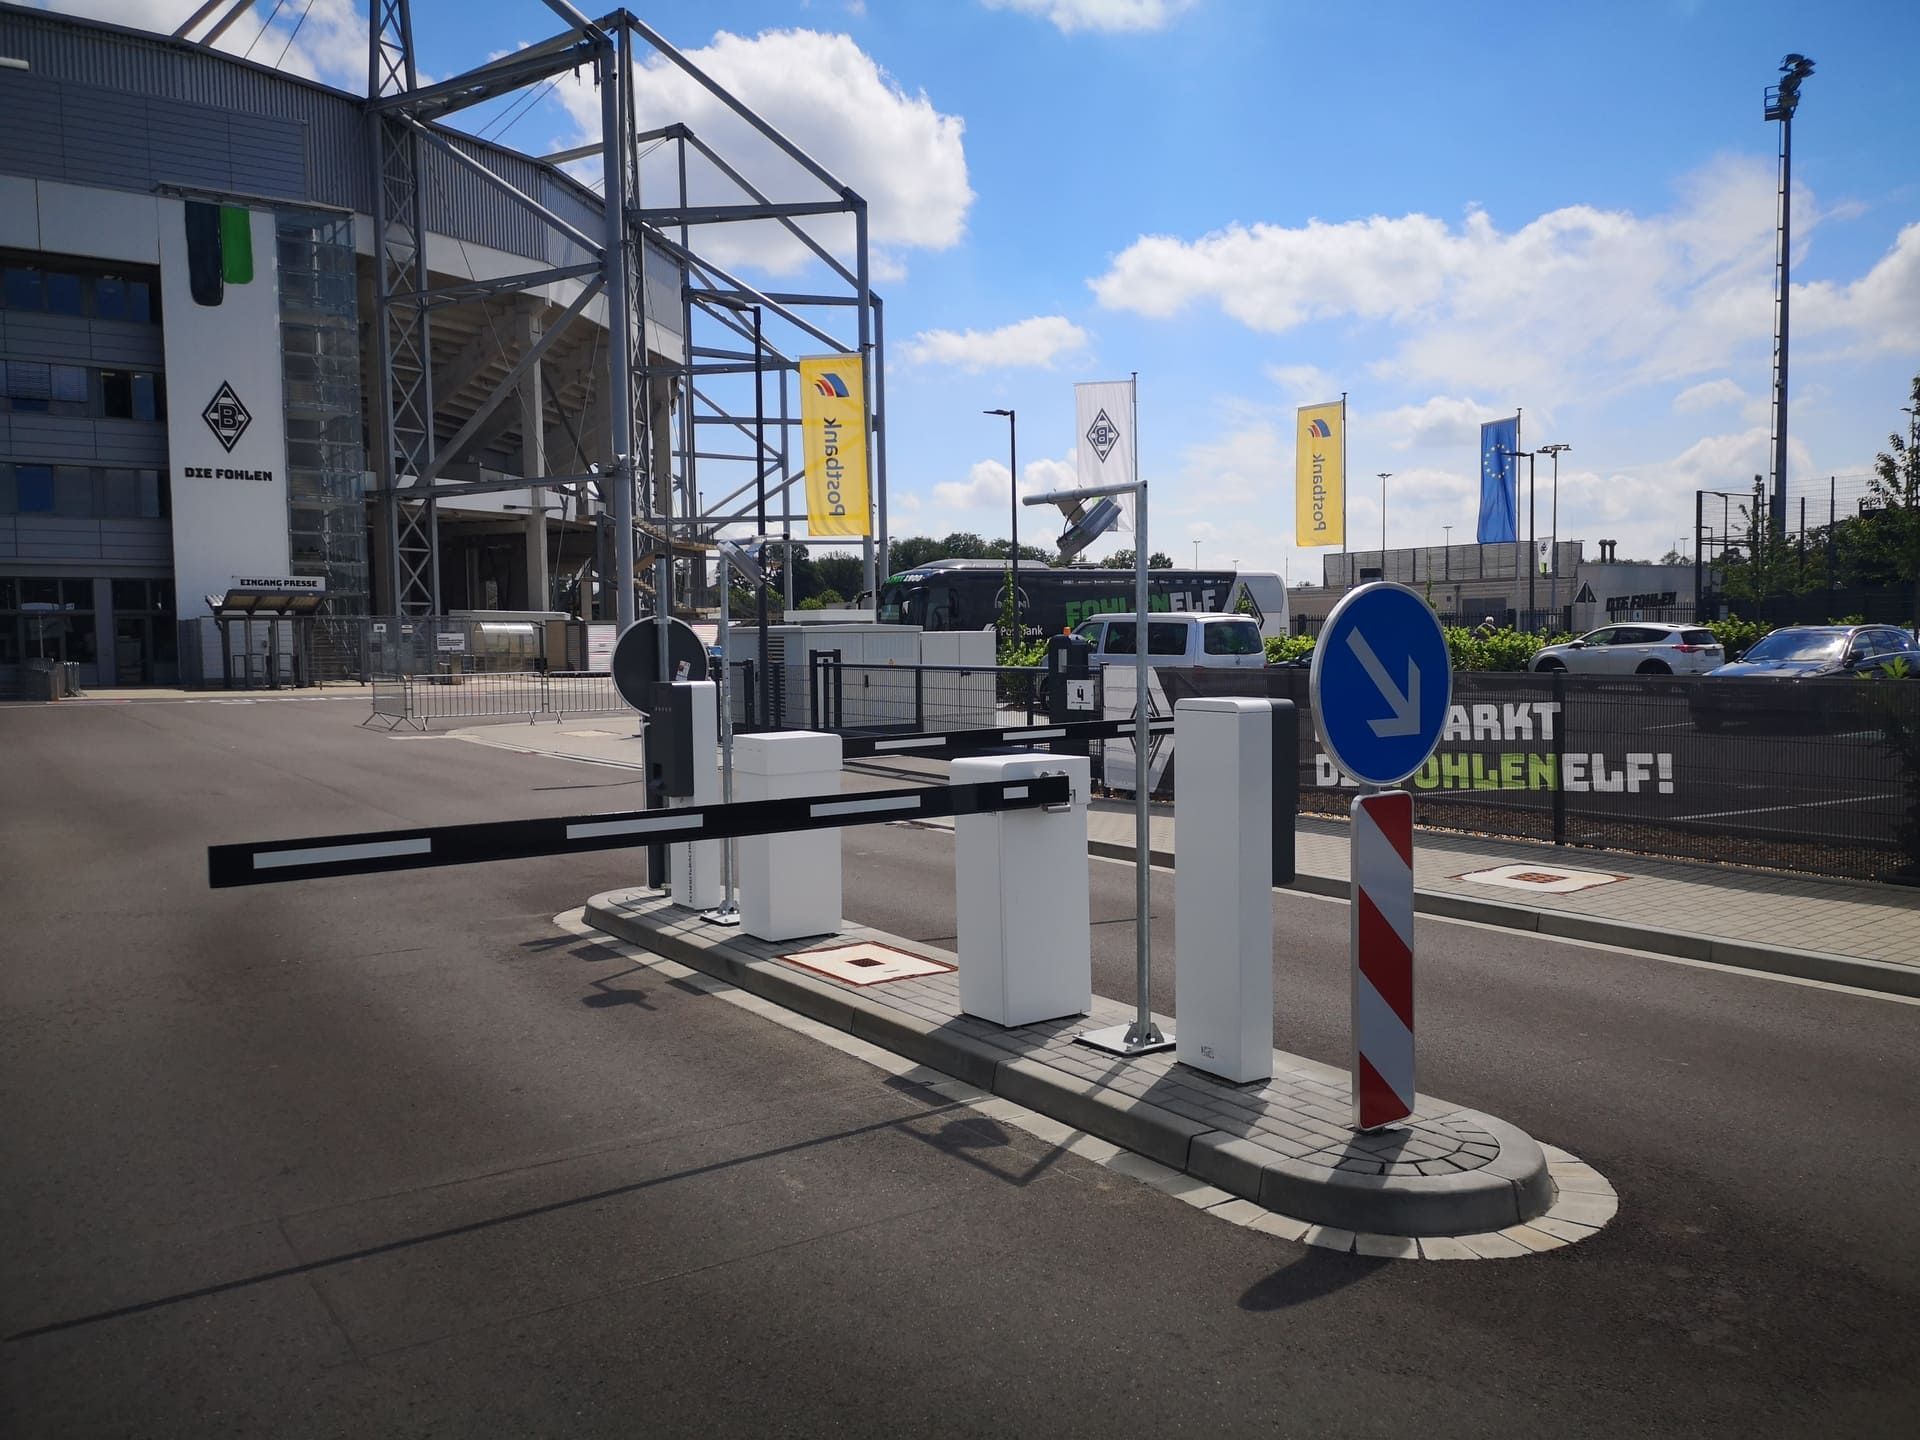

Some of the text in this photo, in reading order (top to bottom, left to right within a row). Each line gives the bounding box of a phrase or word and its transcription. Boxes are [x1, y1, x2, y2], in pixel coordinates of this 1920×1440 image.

[184, 467, 273, 481] DIE FOHLEN
[240, 579, 318, 587] EINGANG PRESSE
[1391, 752, 1674, 794] OHLENELF!
